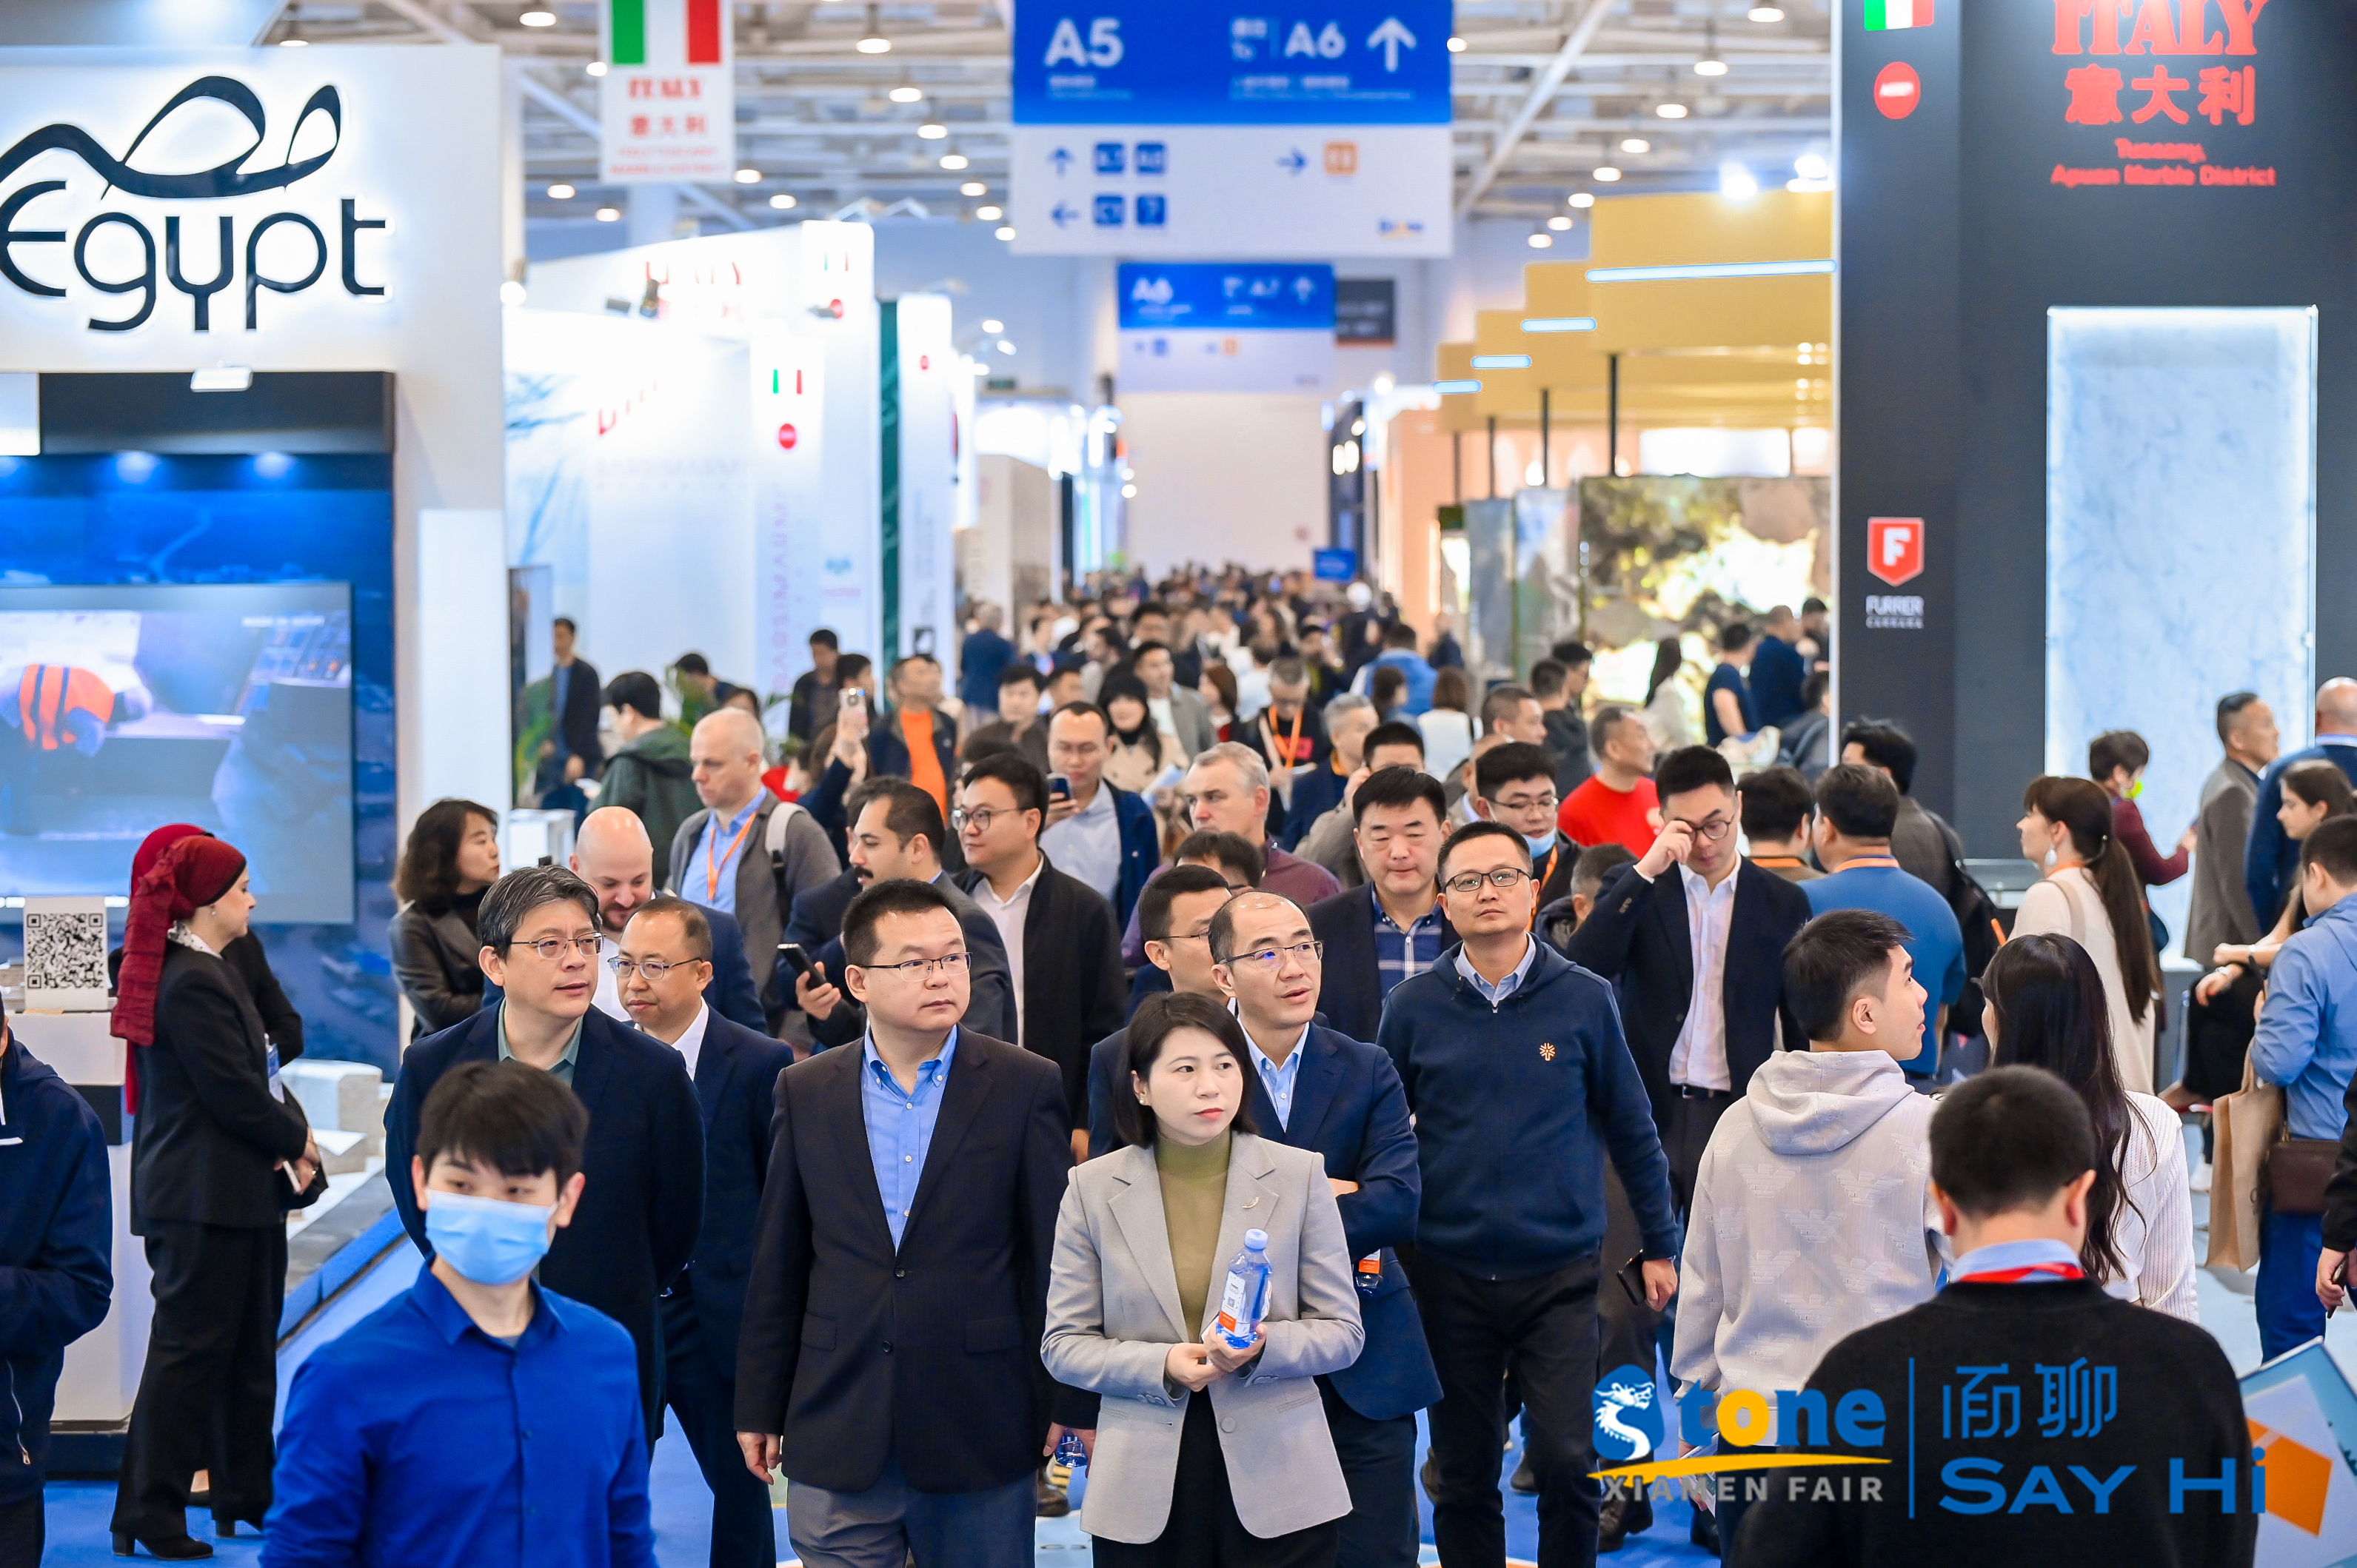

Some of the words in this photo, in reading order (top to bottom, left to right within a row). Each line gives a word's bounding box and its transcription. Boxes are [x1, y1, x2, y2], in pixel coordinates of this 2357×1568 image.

[1043, 16, 1124, 68] A5
[1285, 19, 1346, 58] A6
[2052, 0, 2270, 55] ITALY
[2065, 64, 2256, 125] 意大利
[0, 181, 386, 332] Egypt
